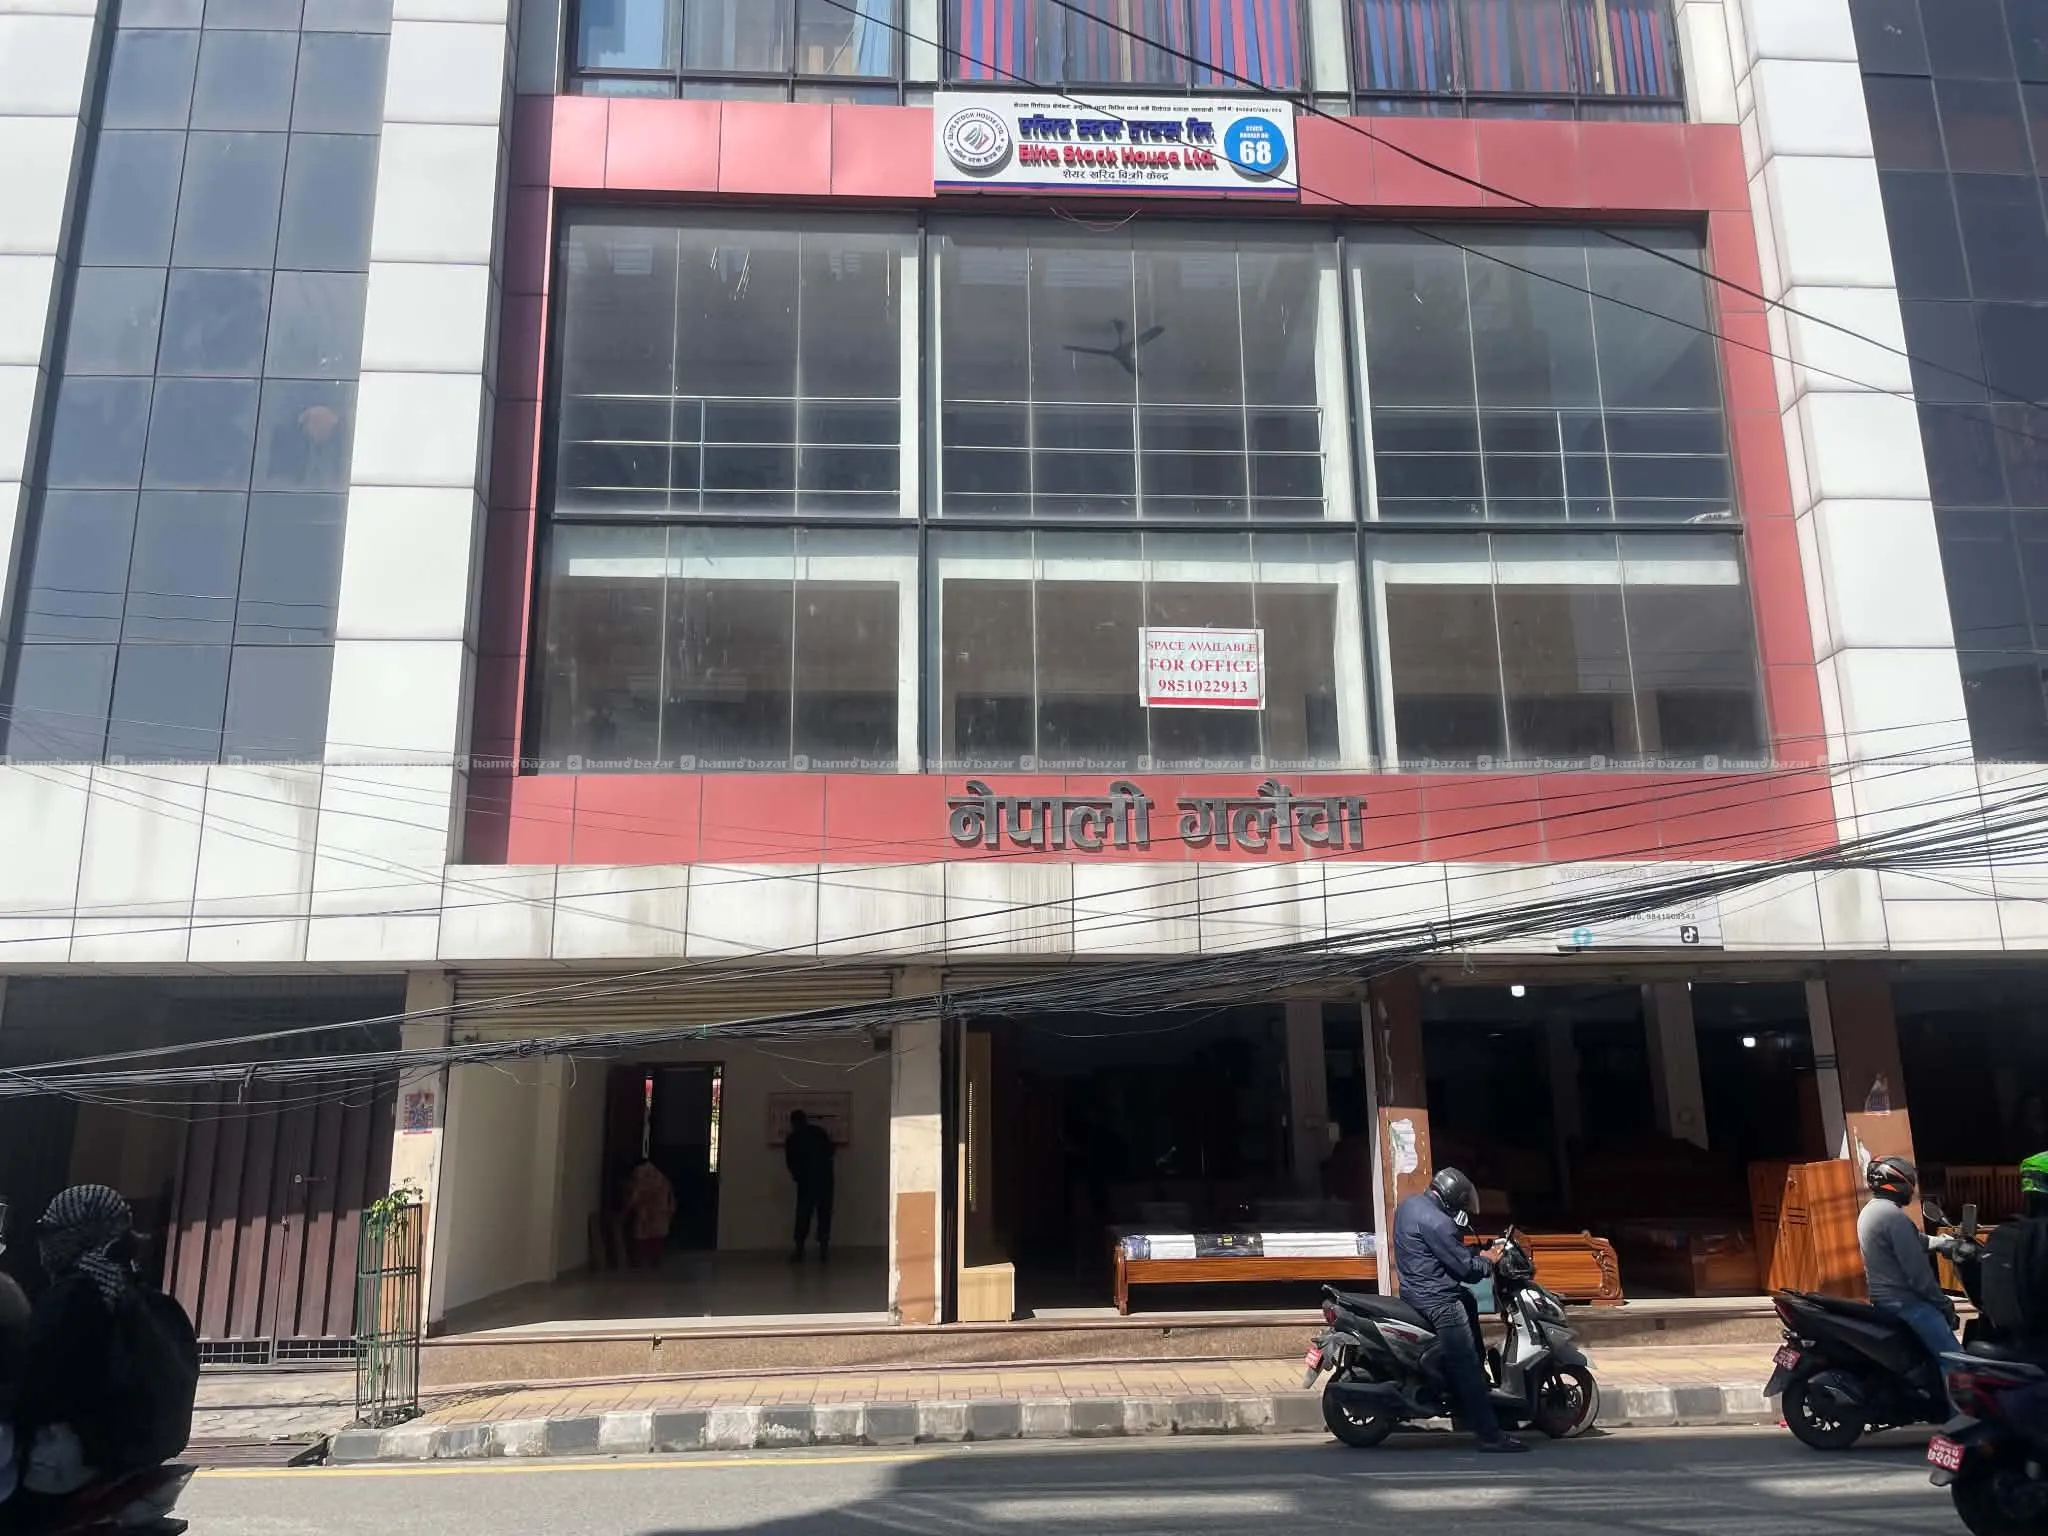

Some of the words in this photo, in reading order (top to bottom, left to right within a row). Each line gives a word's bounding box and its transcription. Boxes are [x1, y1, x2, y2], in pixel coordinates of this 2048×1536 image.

[1018, 144, 1059, 163] Elite
[1063, 145, 1116, 165] Stock
[1120, 146, 1179, 166] House
[1183, 147, 1217, 167] Ltd.
[1240, 140, 1272, 164] 68
[1148, 641, 1184, 651] SPACE
[1189, 641, 1257, 652] AVAILABLE
[1149, 658, 1184, 672] FOR
[1190, 659, 1256, 673] OFFICE
[1158, 679, 1248, 693] 9851022913
[948, 780, 1151, 848] नेपाली
